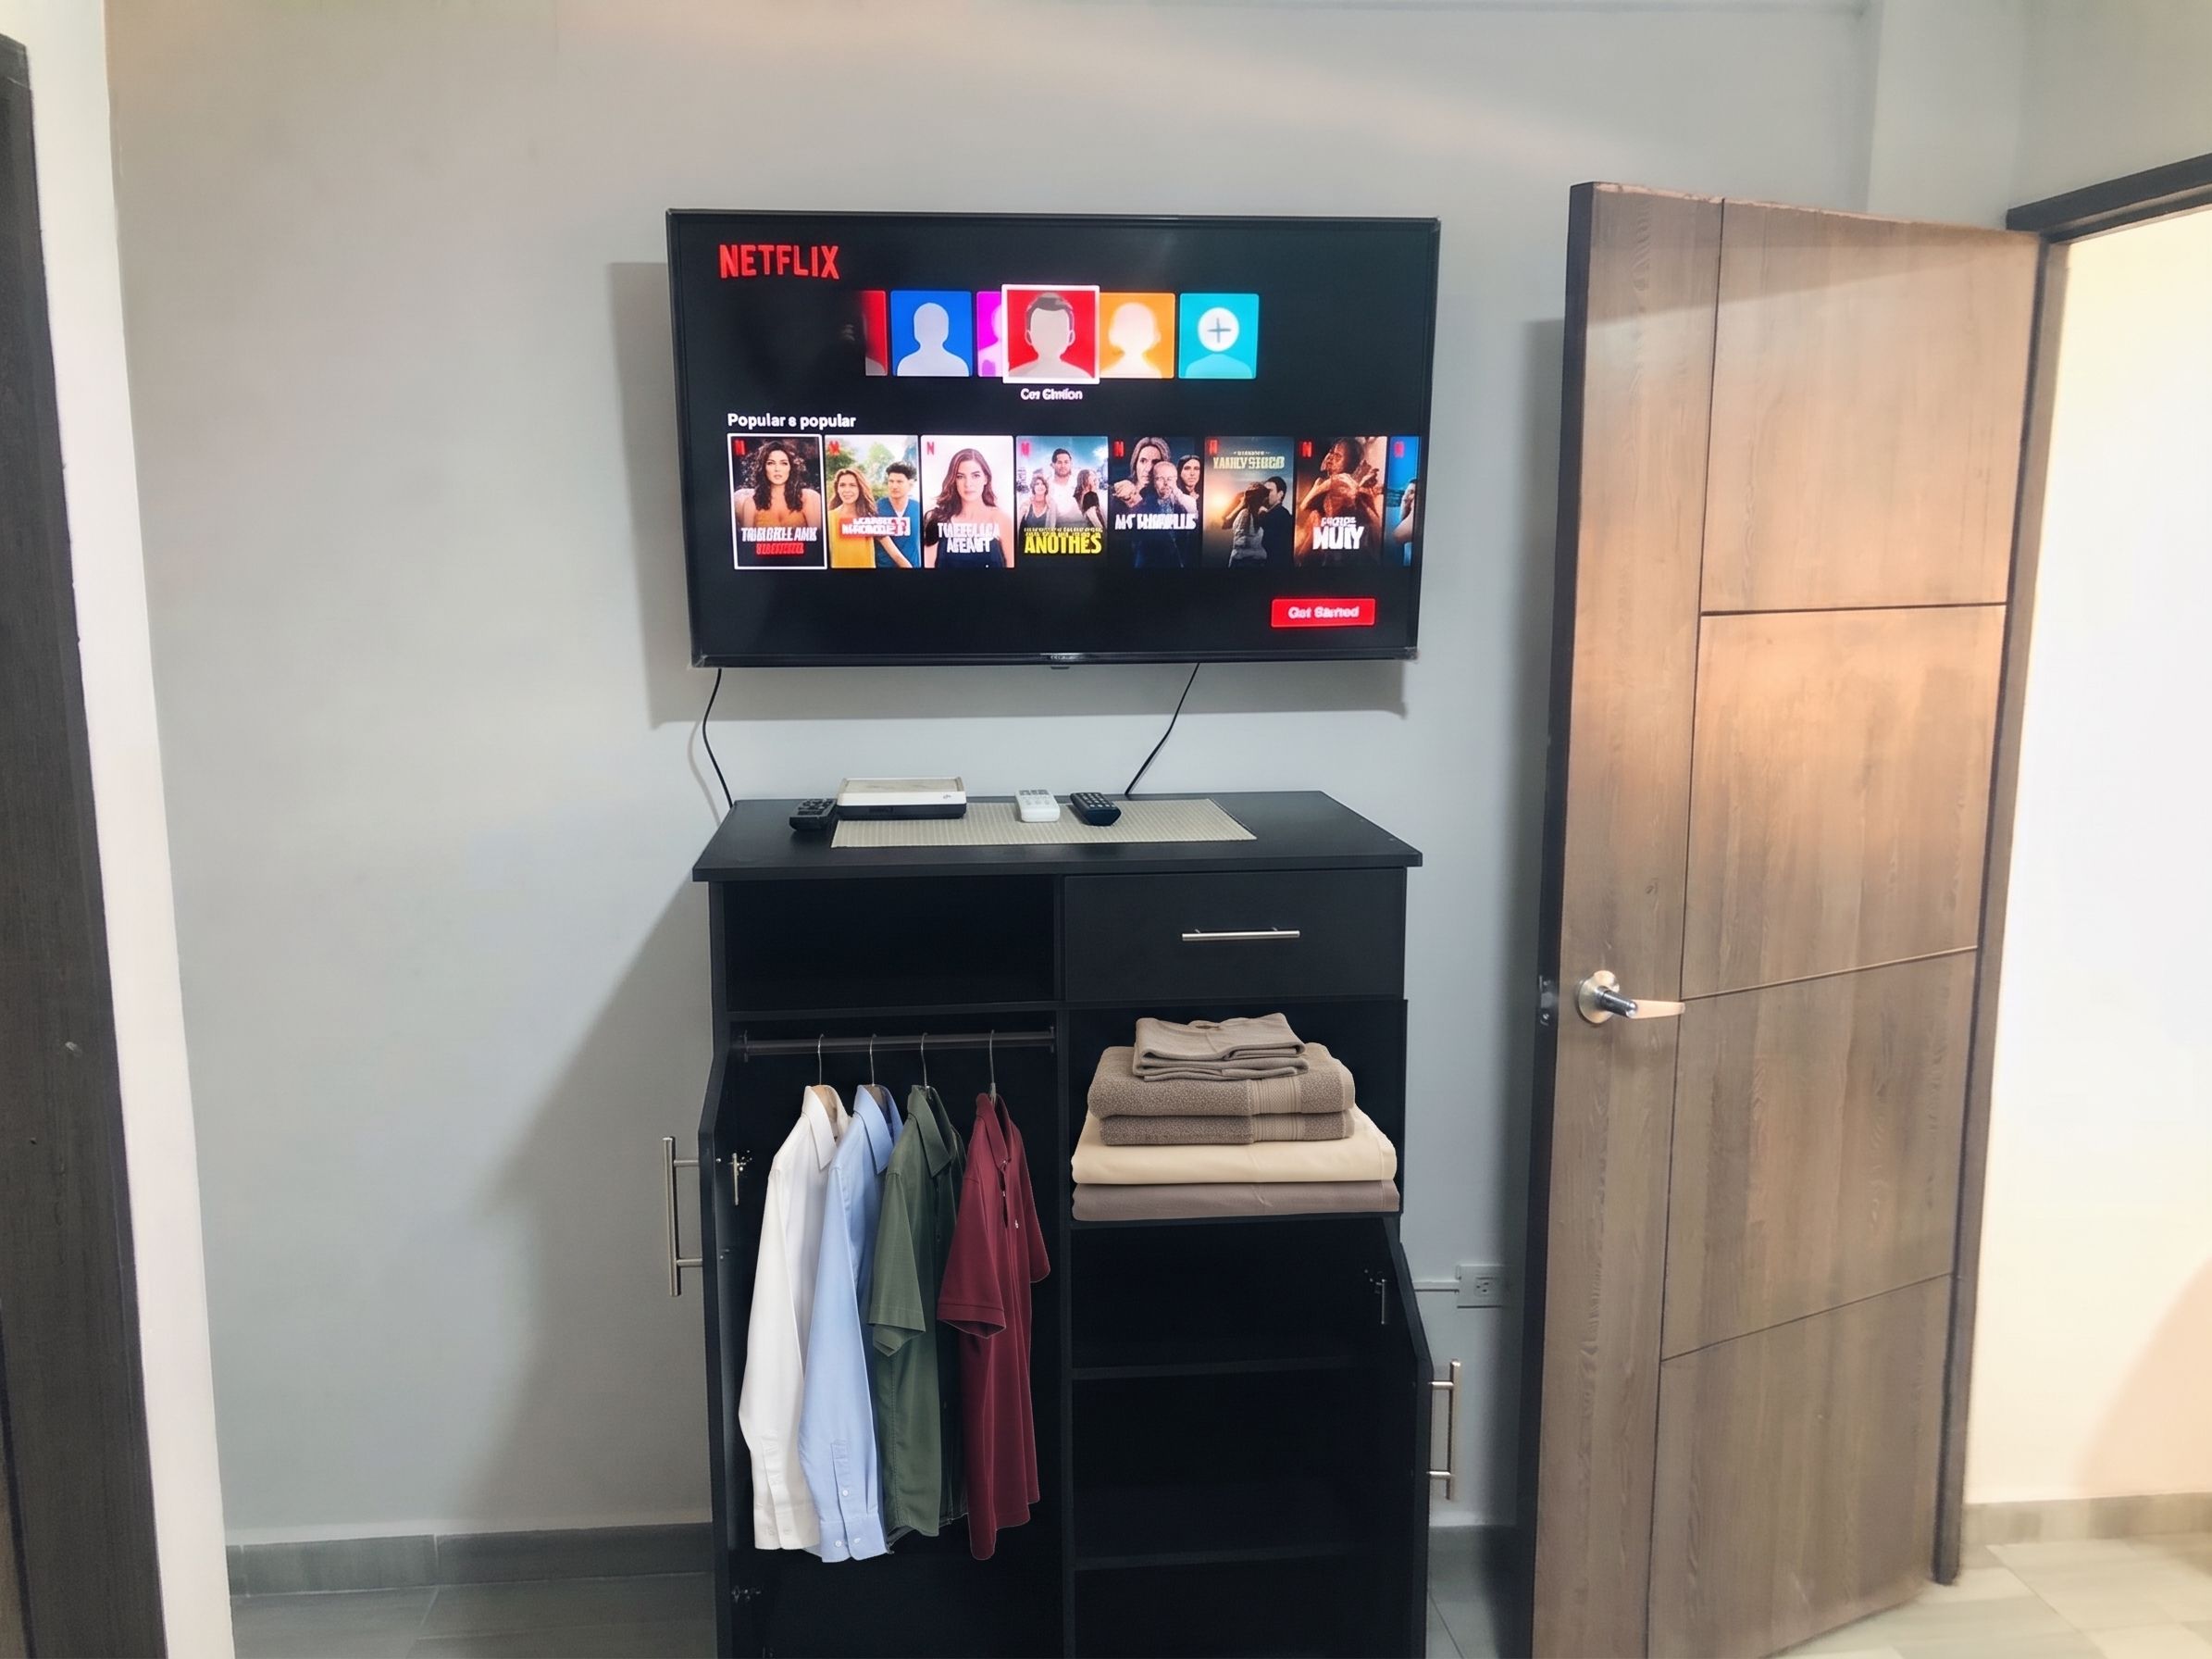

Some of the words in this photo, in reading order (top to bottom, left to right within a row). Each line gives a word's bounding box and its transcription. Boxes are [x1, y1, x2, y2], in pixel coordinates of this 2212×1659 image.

[719, 243, 840, 280] NETFLIX
[727, 412, 787, 430] Popular
[799, 413, 857, 430] popular
[926, 441, 935, 455] N
[1024, 533, 1102, 555] ANOTHES
